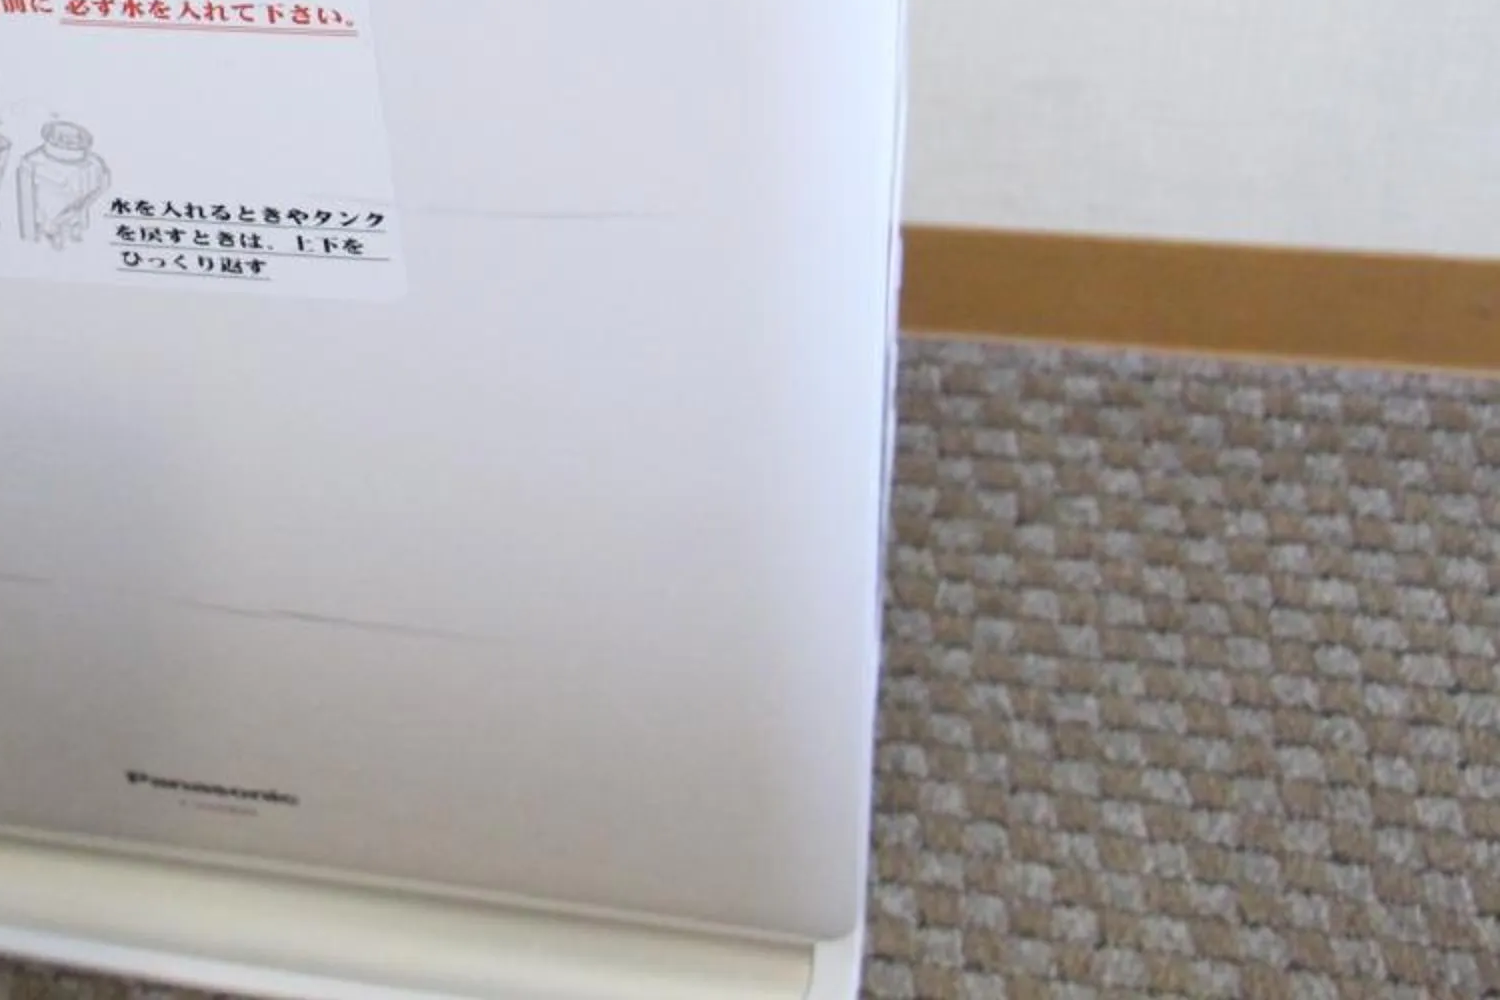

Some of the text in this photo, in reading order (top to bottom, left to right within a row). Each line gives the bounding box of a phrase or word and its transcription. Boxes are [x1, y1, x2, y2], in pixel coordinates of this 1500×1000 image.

[110, 196, 386, 228] 水を入れるときやタンク
[120, 250, 268, 275] ひっくり返す
[126, 770, 299, 806] Panasonic
